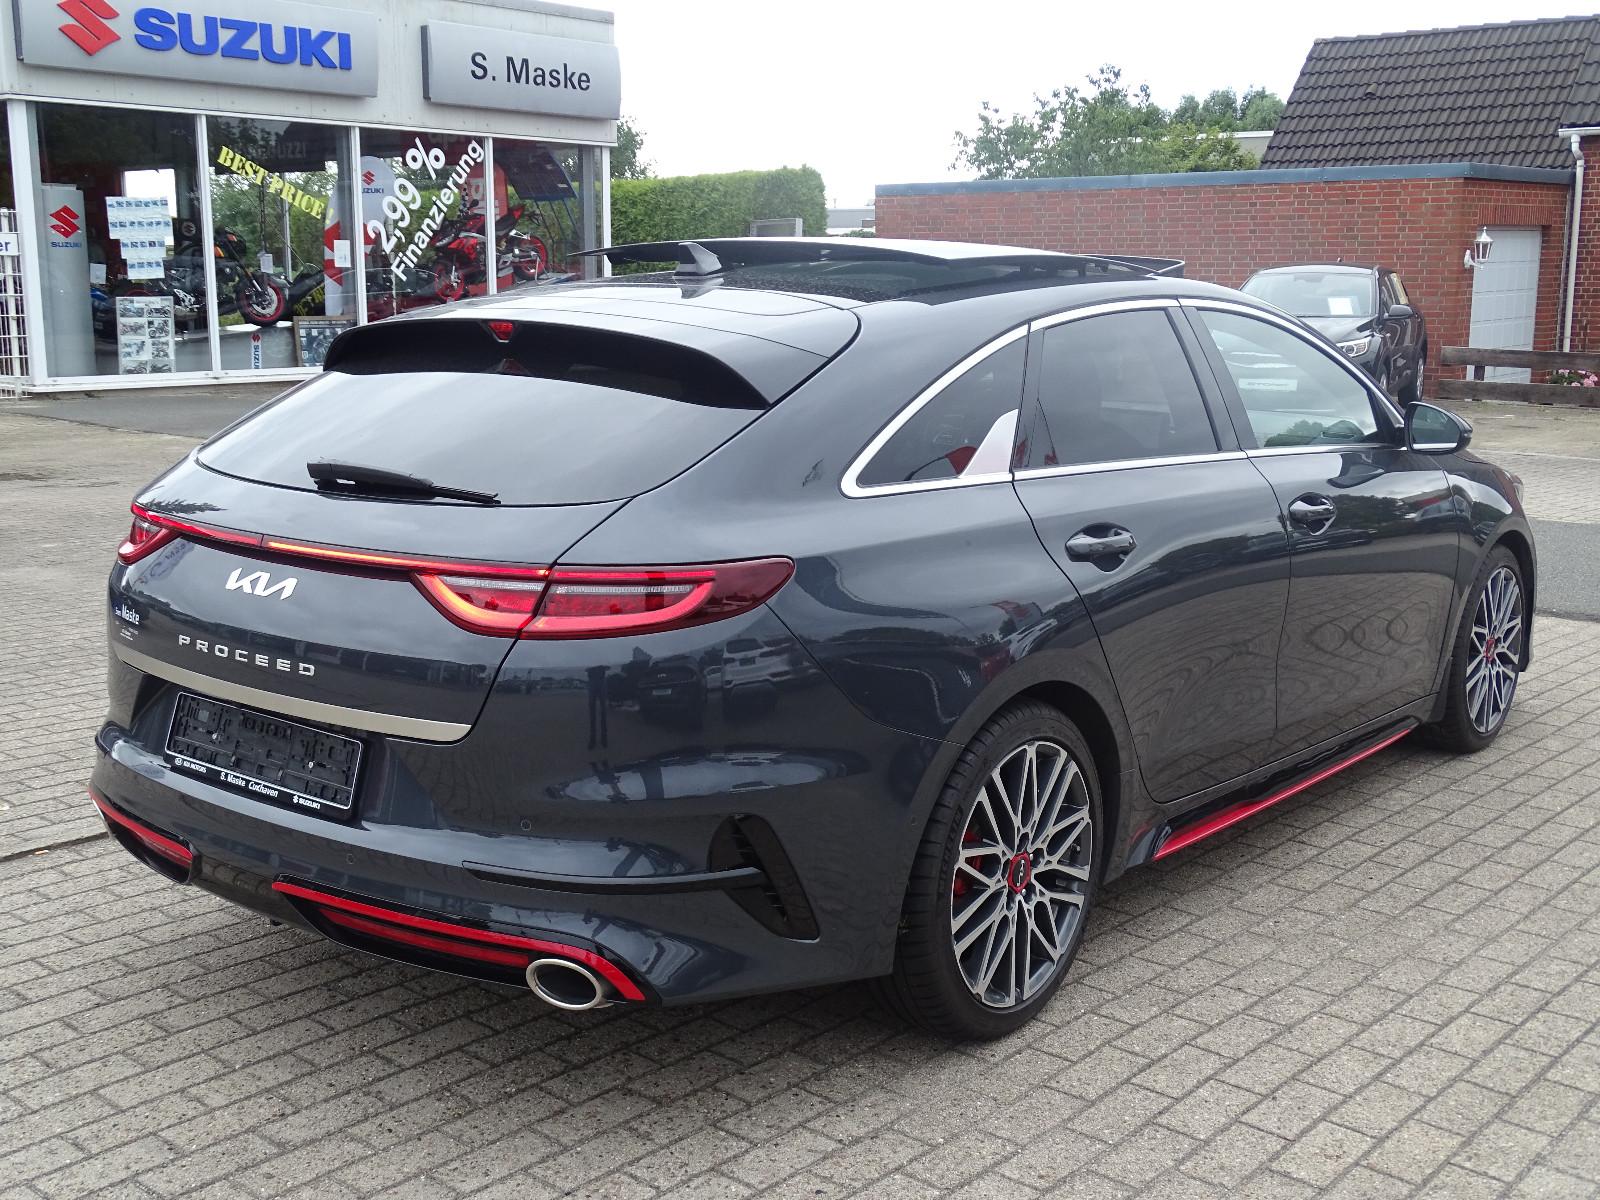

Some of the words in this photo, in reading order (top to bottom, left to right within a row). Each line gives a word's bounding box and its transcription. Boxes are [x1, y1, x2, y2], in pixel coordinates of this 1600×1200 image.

[134, 7, 352, 71] SUZUKI
[470, 51, 497, 83] S.
[506, 55, 592, 92] Maske
[217, 145, 269, 186] BEST
[268, 174, 325, 220] PRICE
[367, 177, 422, 255] 2,99
[405, 136, 446, 181] %
[390, 138, 485, 282] Finanzierung
[225, 567, 299, 600] KIA
[178, 634, 316, 677] PROCEED
[227, 774, 246, 787] Maske
[248, 782, 279, 798] Cuxhaven
